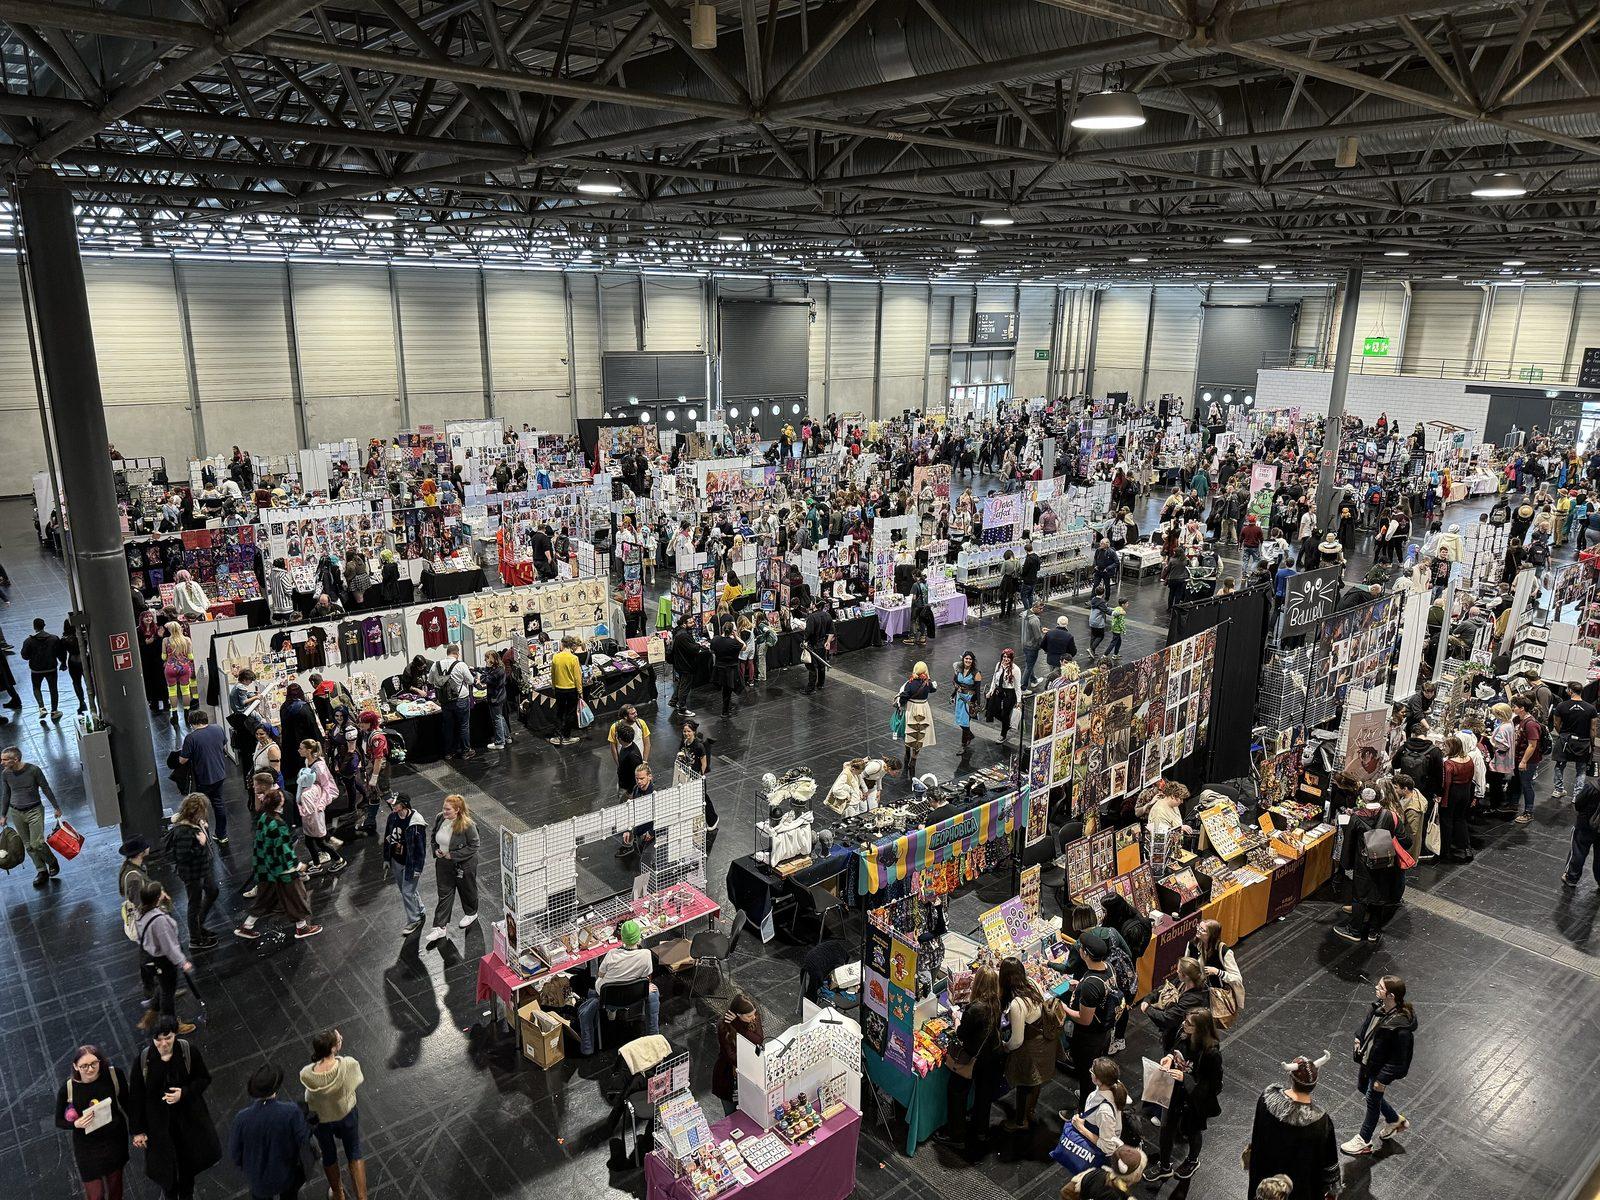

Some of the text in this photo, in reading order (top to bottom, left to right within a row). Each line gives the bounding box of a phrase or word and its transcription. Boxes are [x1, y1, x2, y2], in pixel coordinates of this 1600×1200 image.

[930, 818, 977, 849] NEOPHOBICA
[1160, 918, 1198, 946] Kabujiro
[1061, 1137, 1096, 1164] ACTION
